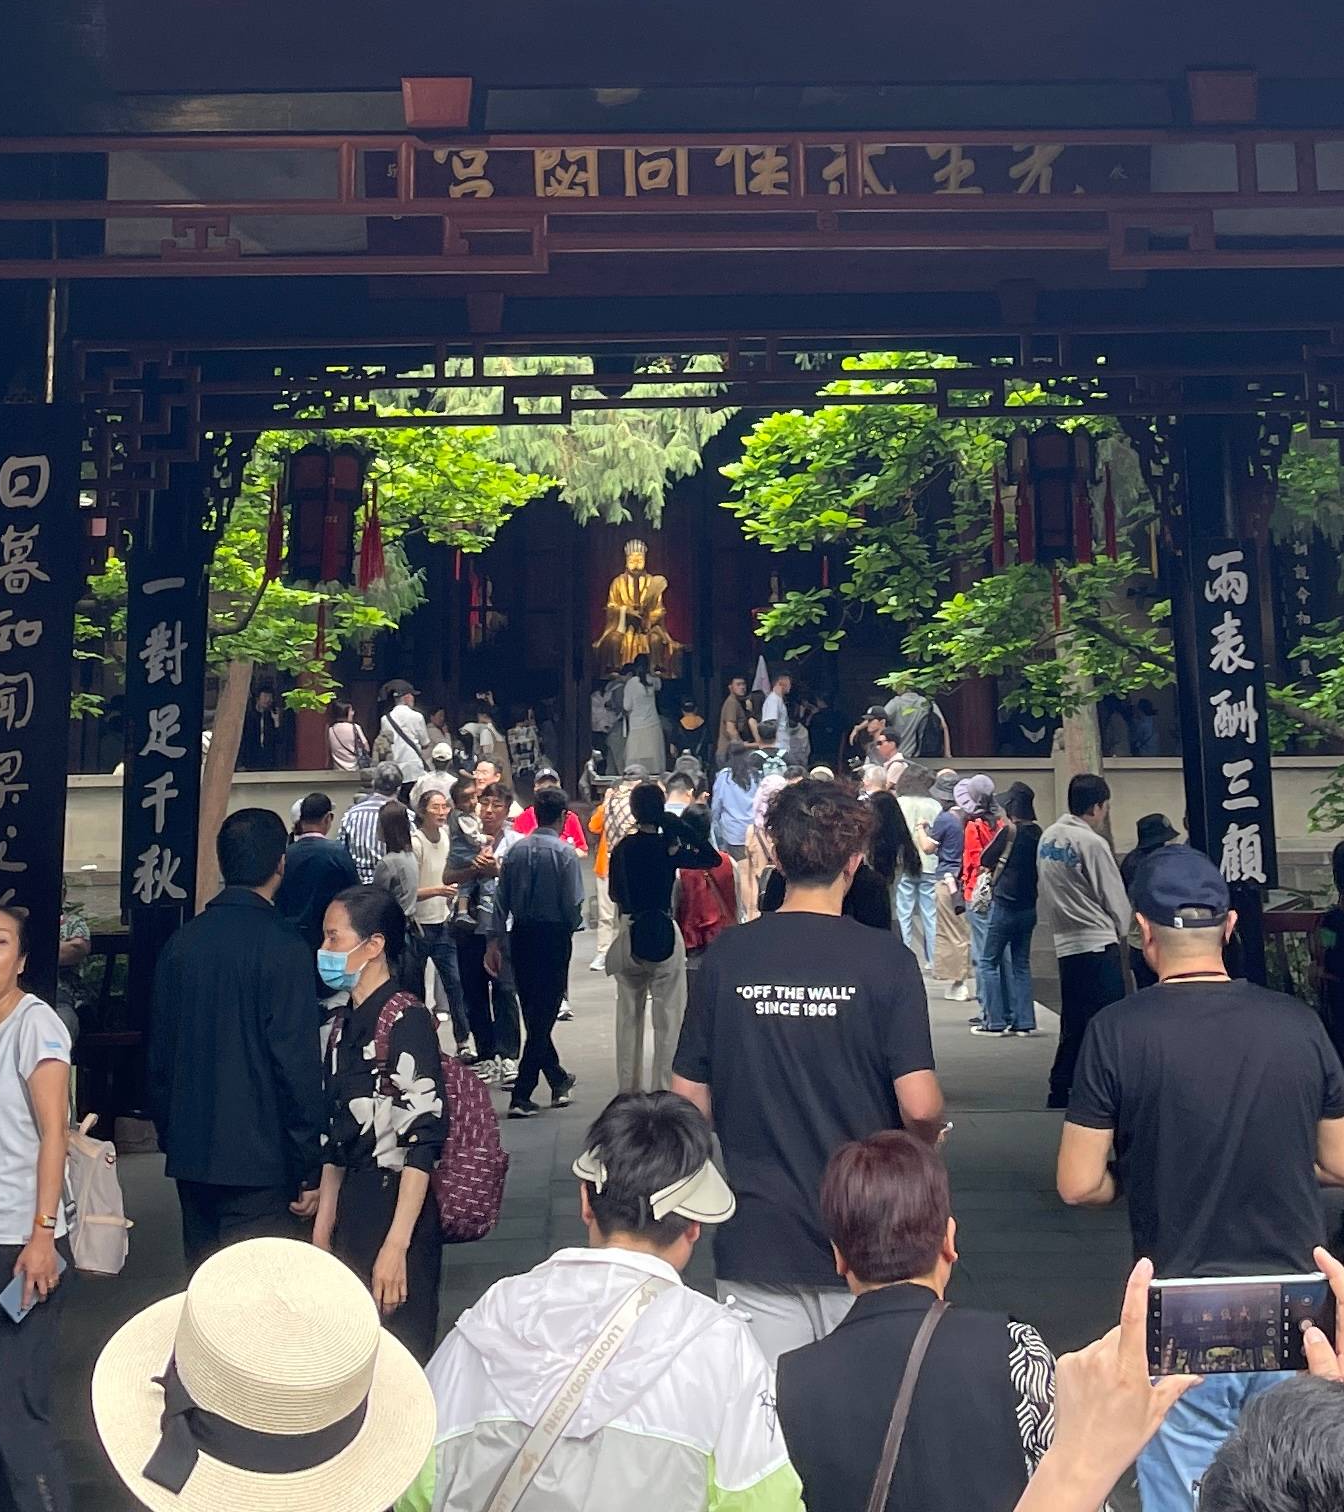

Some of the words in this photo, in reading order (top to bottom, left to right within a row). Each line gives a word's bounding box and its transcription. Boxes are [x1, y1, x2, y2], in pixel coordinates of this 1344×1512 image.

[774, 986, 806, 1001] THE
[755, 1001, 800, 1017] SINCE
[802, 1002, 837, 1018] 1966
